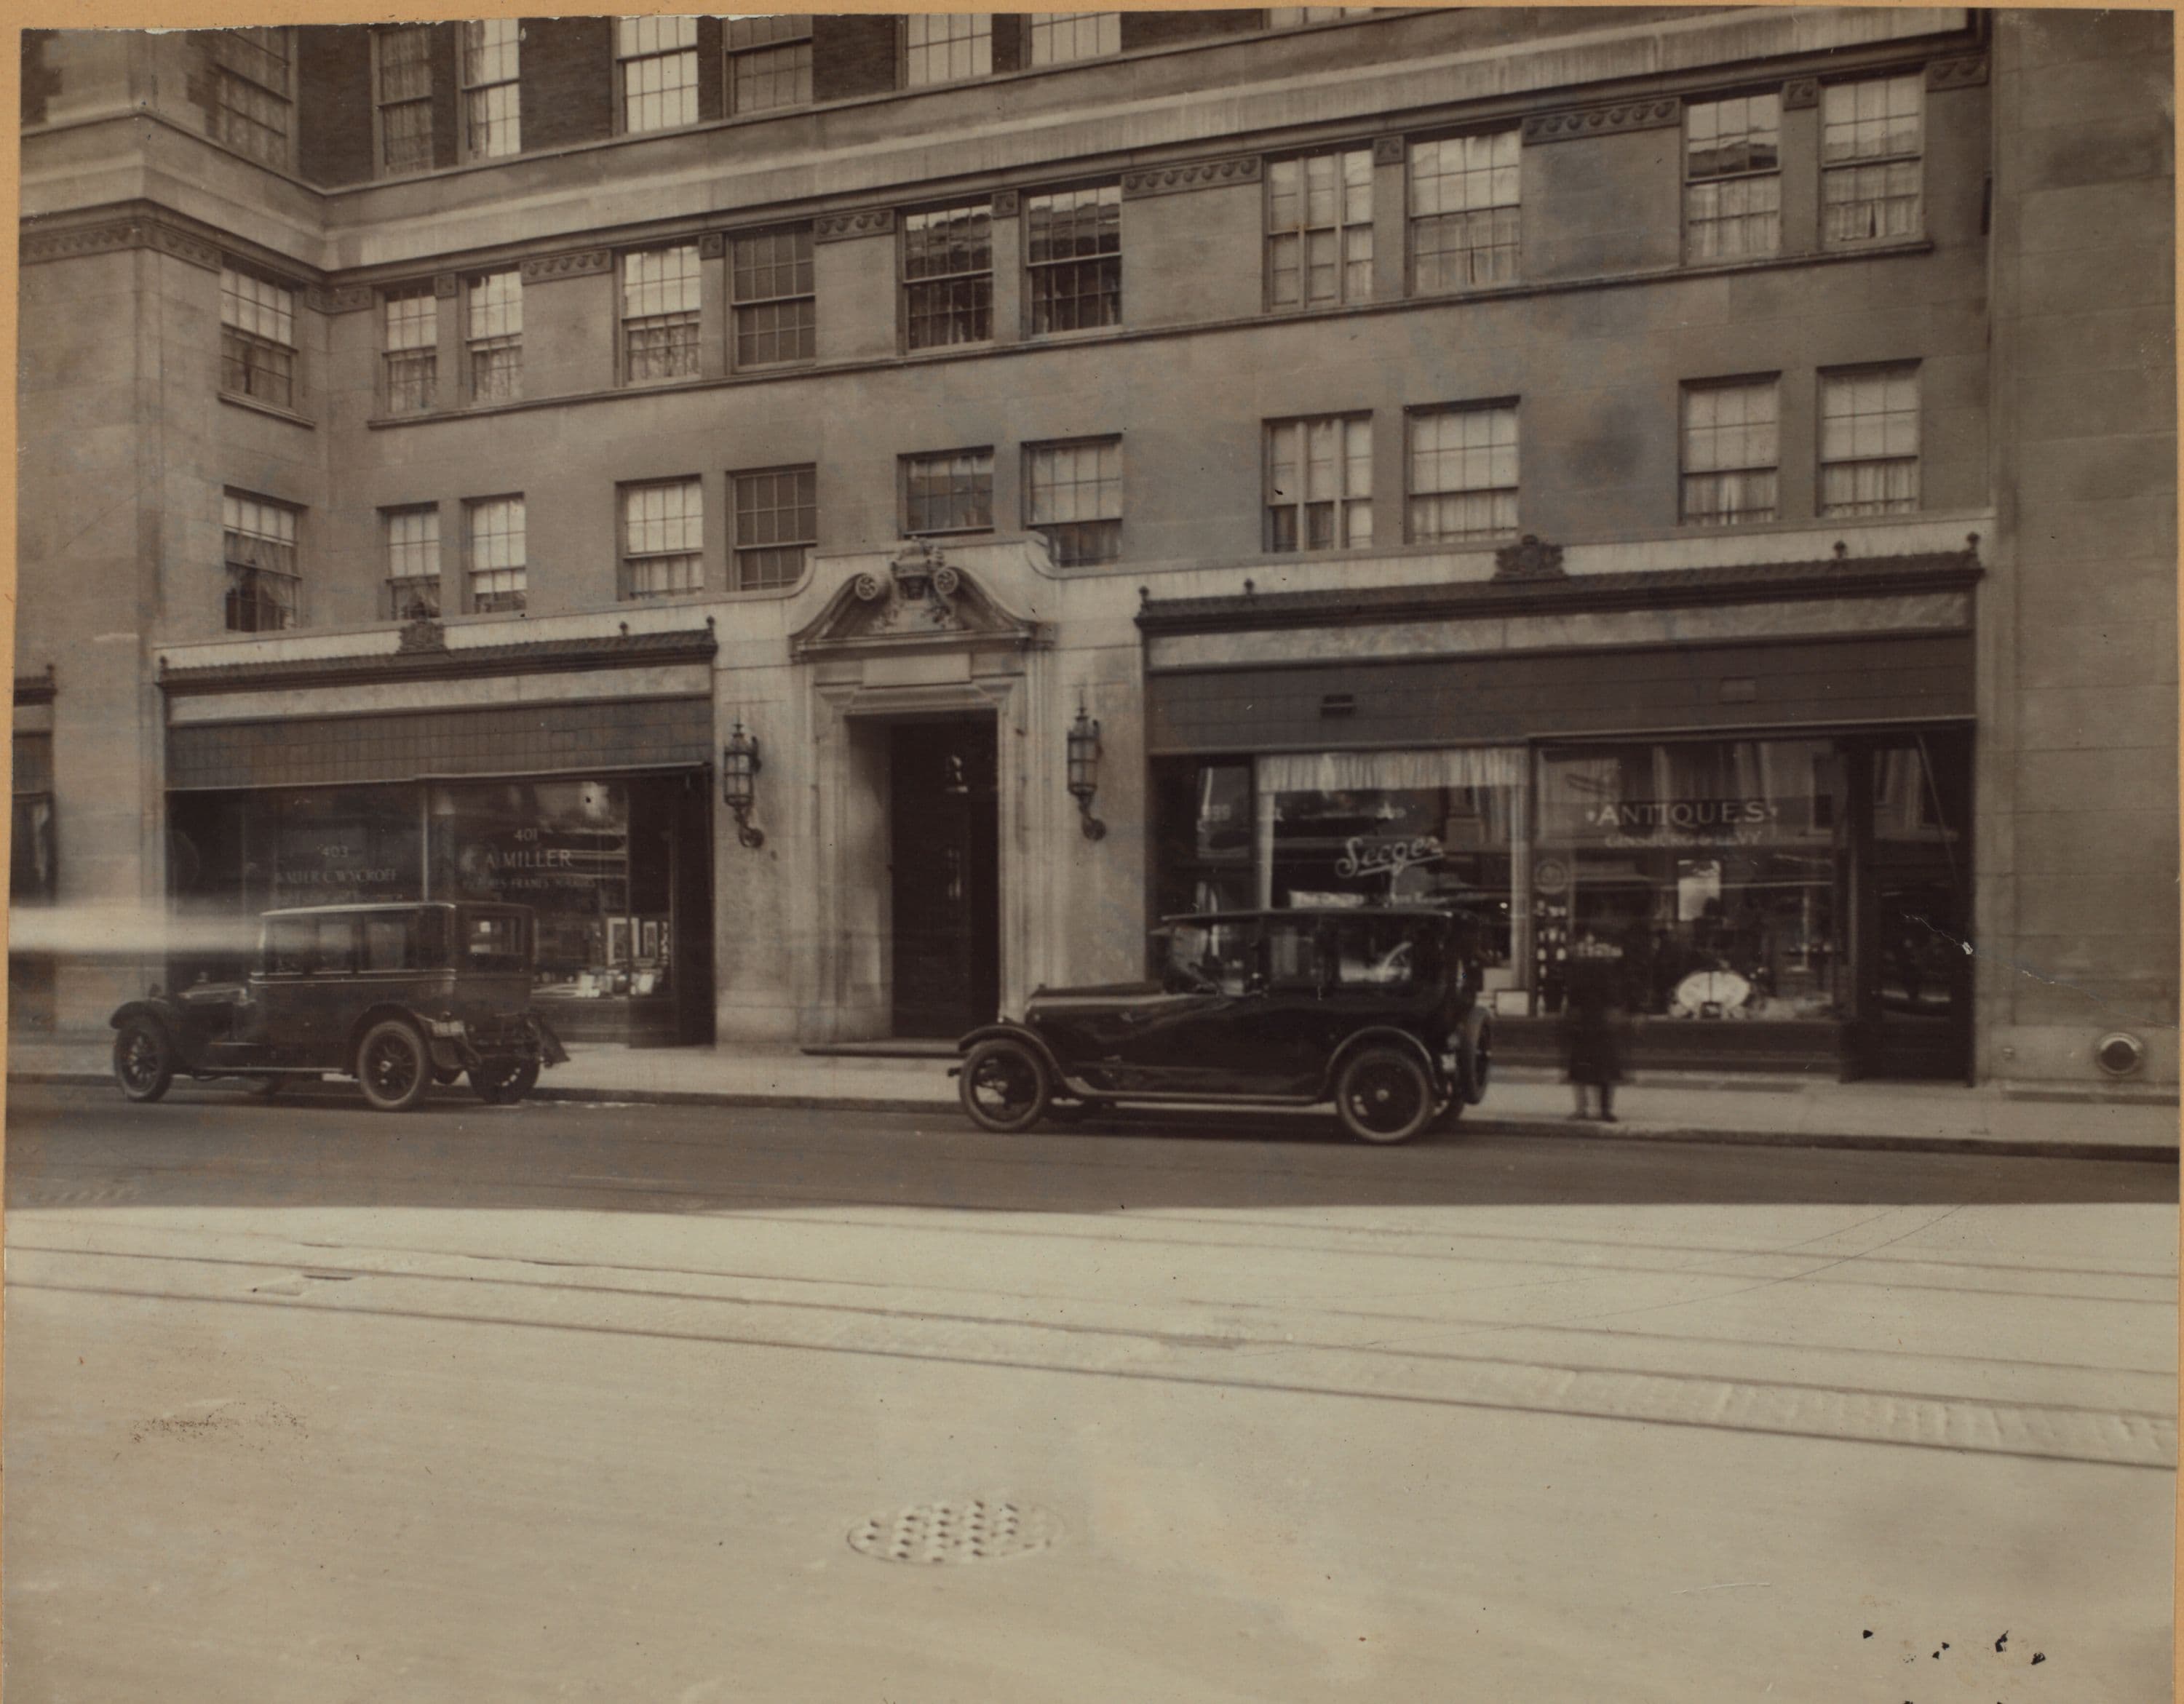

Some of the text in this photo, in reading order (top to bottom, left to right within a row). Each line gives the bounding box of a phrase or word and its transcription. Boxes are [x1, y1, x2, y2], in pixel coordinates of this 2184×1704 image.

[1596, 800, 1766, 828] ANTIQUES
[513, 827, 539, 841] 401
[502, 848, 573, 868] MILLER
[1334, 835, 1445, 879] Seeger
